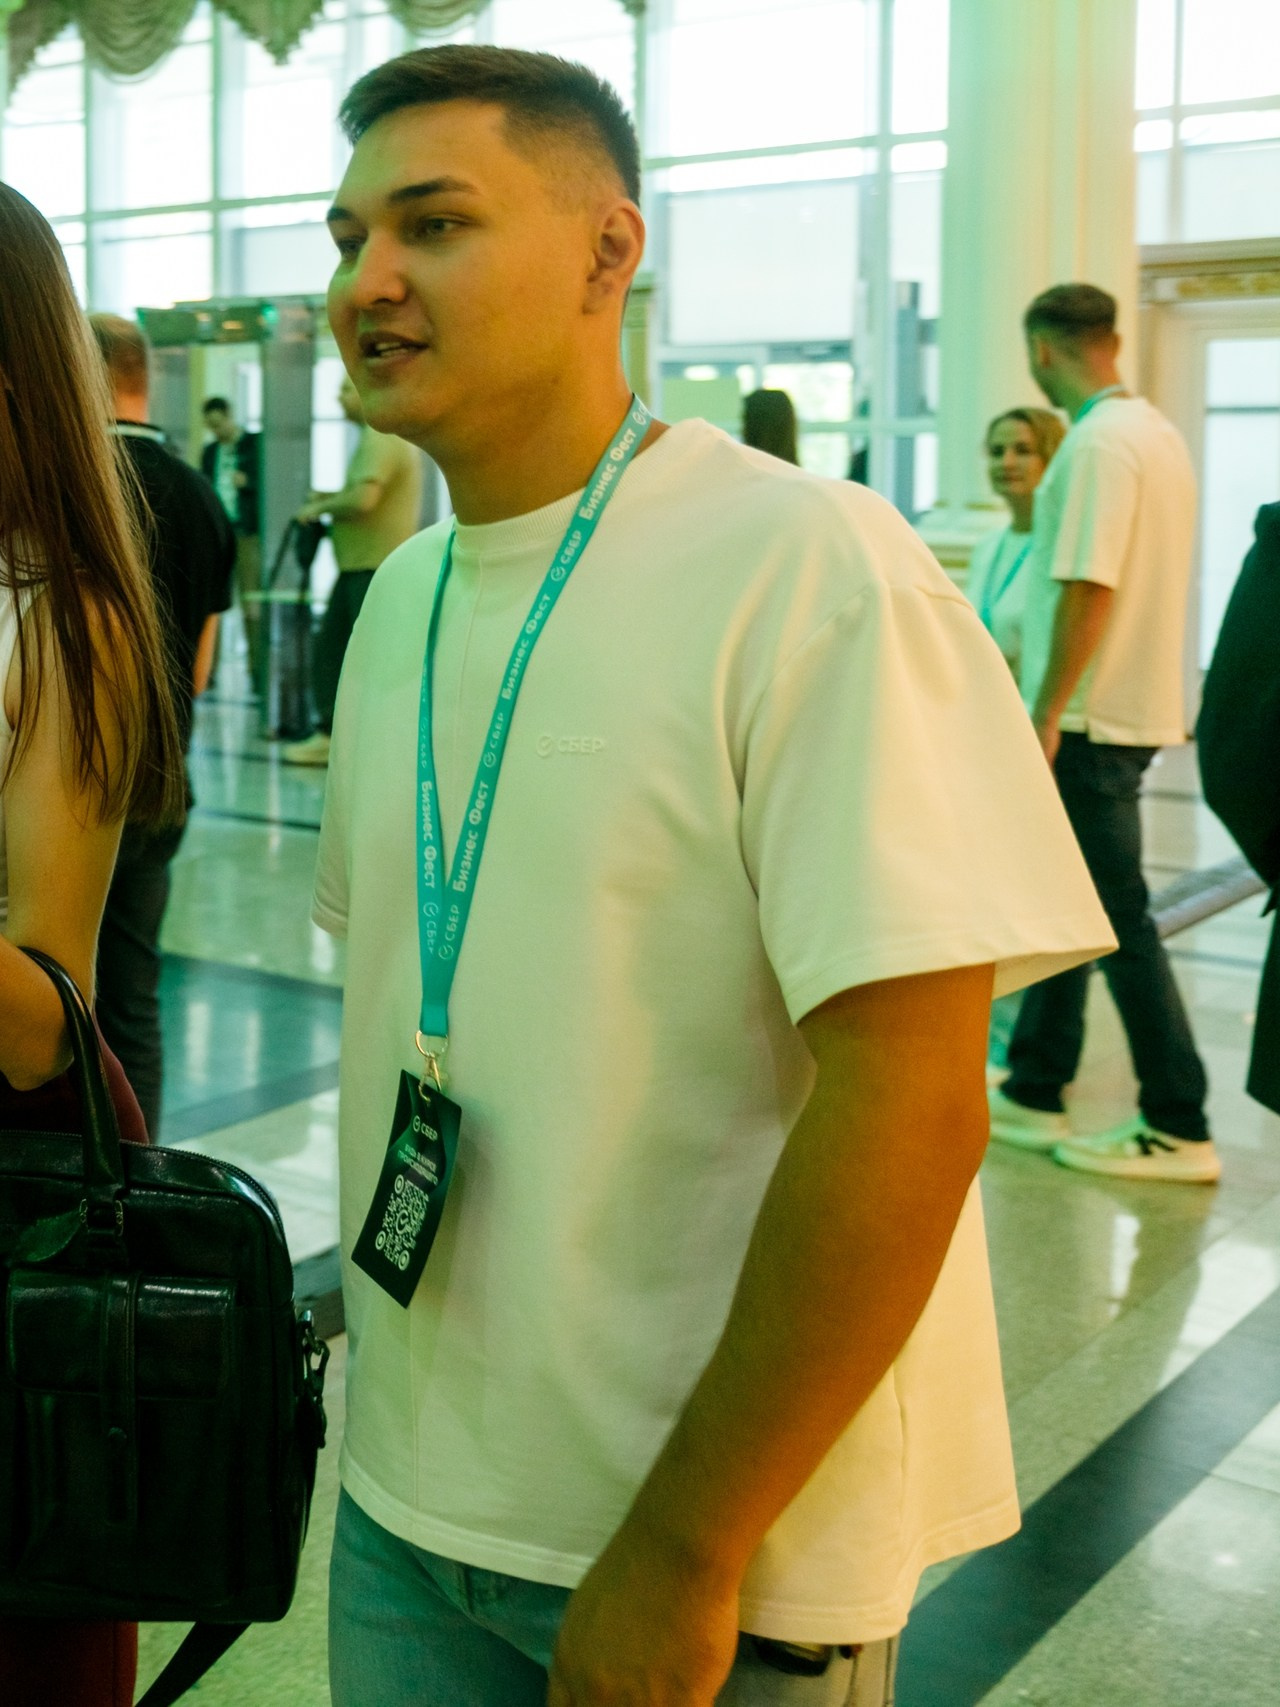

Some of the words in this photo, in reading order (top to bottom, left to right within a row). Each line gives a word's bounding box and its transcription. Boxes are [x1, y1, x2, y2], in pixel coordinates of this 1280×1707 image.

[579, 462, 617, 520] Бизнес
[609, 428, 637, 463] Фест
[560, 529, 583, 565] СБЕР
[501, 638, 530, 700] Бизнес
[525, 592, 552, 635] Фест
[490, 712, 505, 749] СБЕР
[557, 737, 606, 754] СБЕР
[421, 780, 433, 842] Бизнес
[453, 830, 479, 892] Бизнес
[469, 781, 489, 826] Фест
[424, 845, 437, 888] Фест
[444, 904, 460, 941] СБЕР
